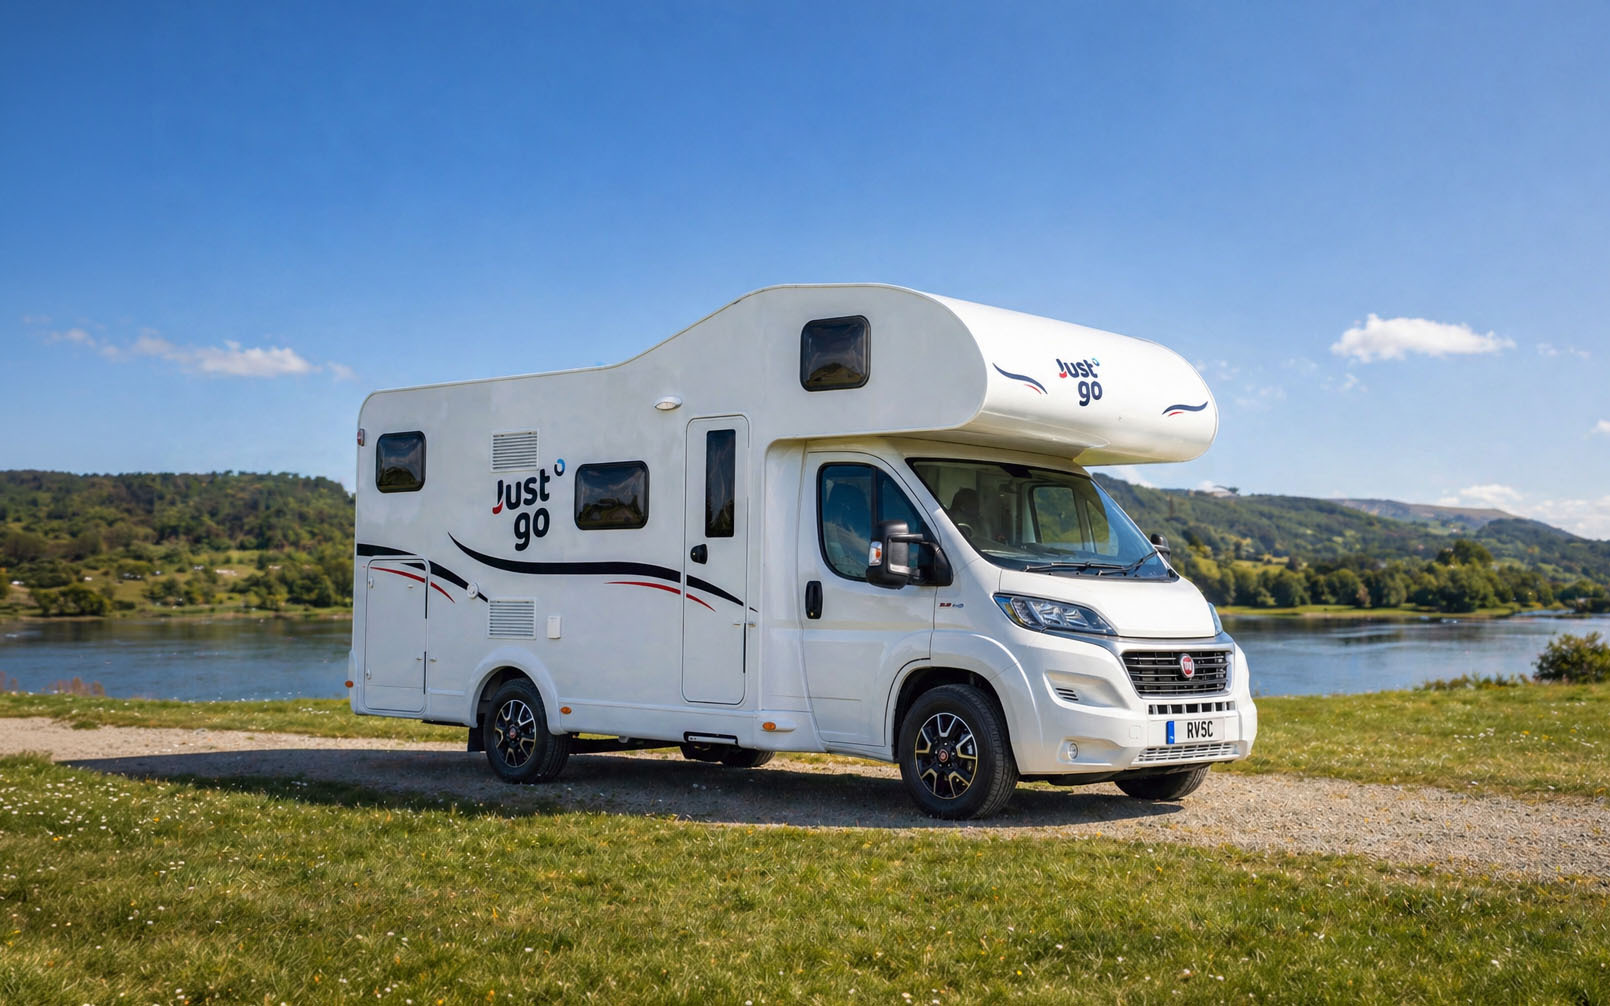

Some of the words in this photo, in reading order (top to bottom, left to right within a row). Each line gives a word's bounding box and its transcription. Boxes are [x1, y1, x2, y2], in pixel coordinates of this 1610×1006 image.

[1056, 358, 1098, 378] Just
[1078, 381, 1103, 407] go
[492, 468, 551, 515] Just
[514, 507, 550, 552] go
